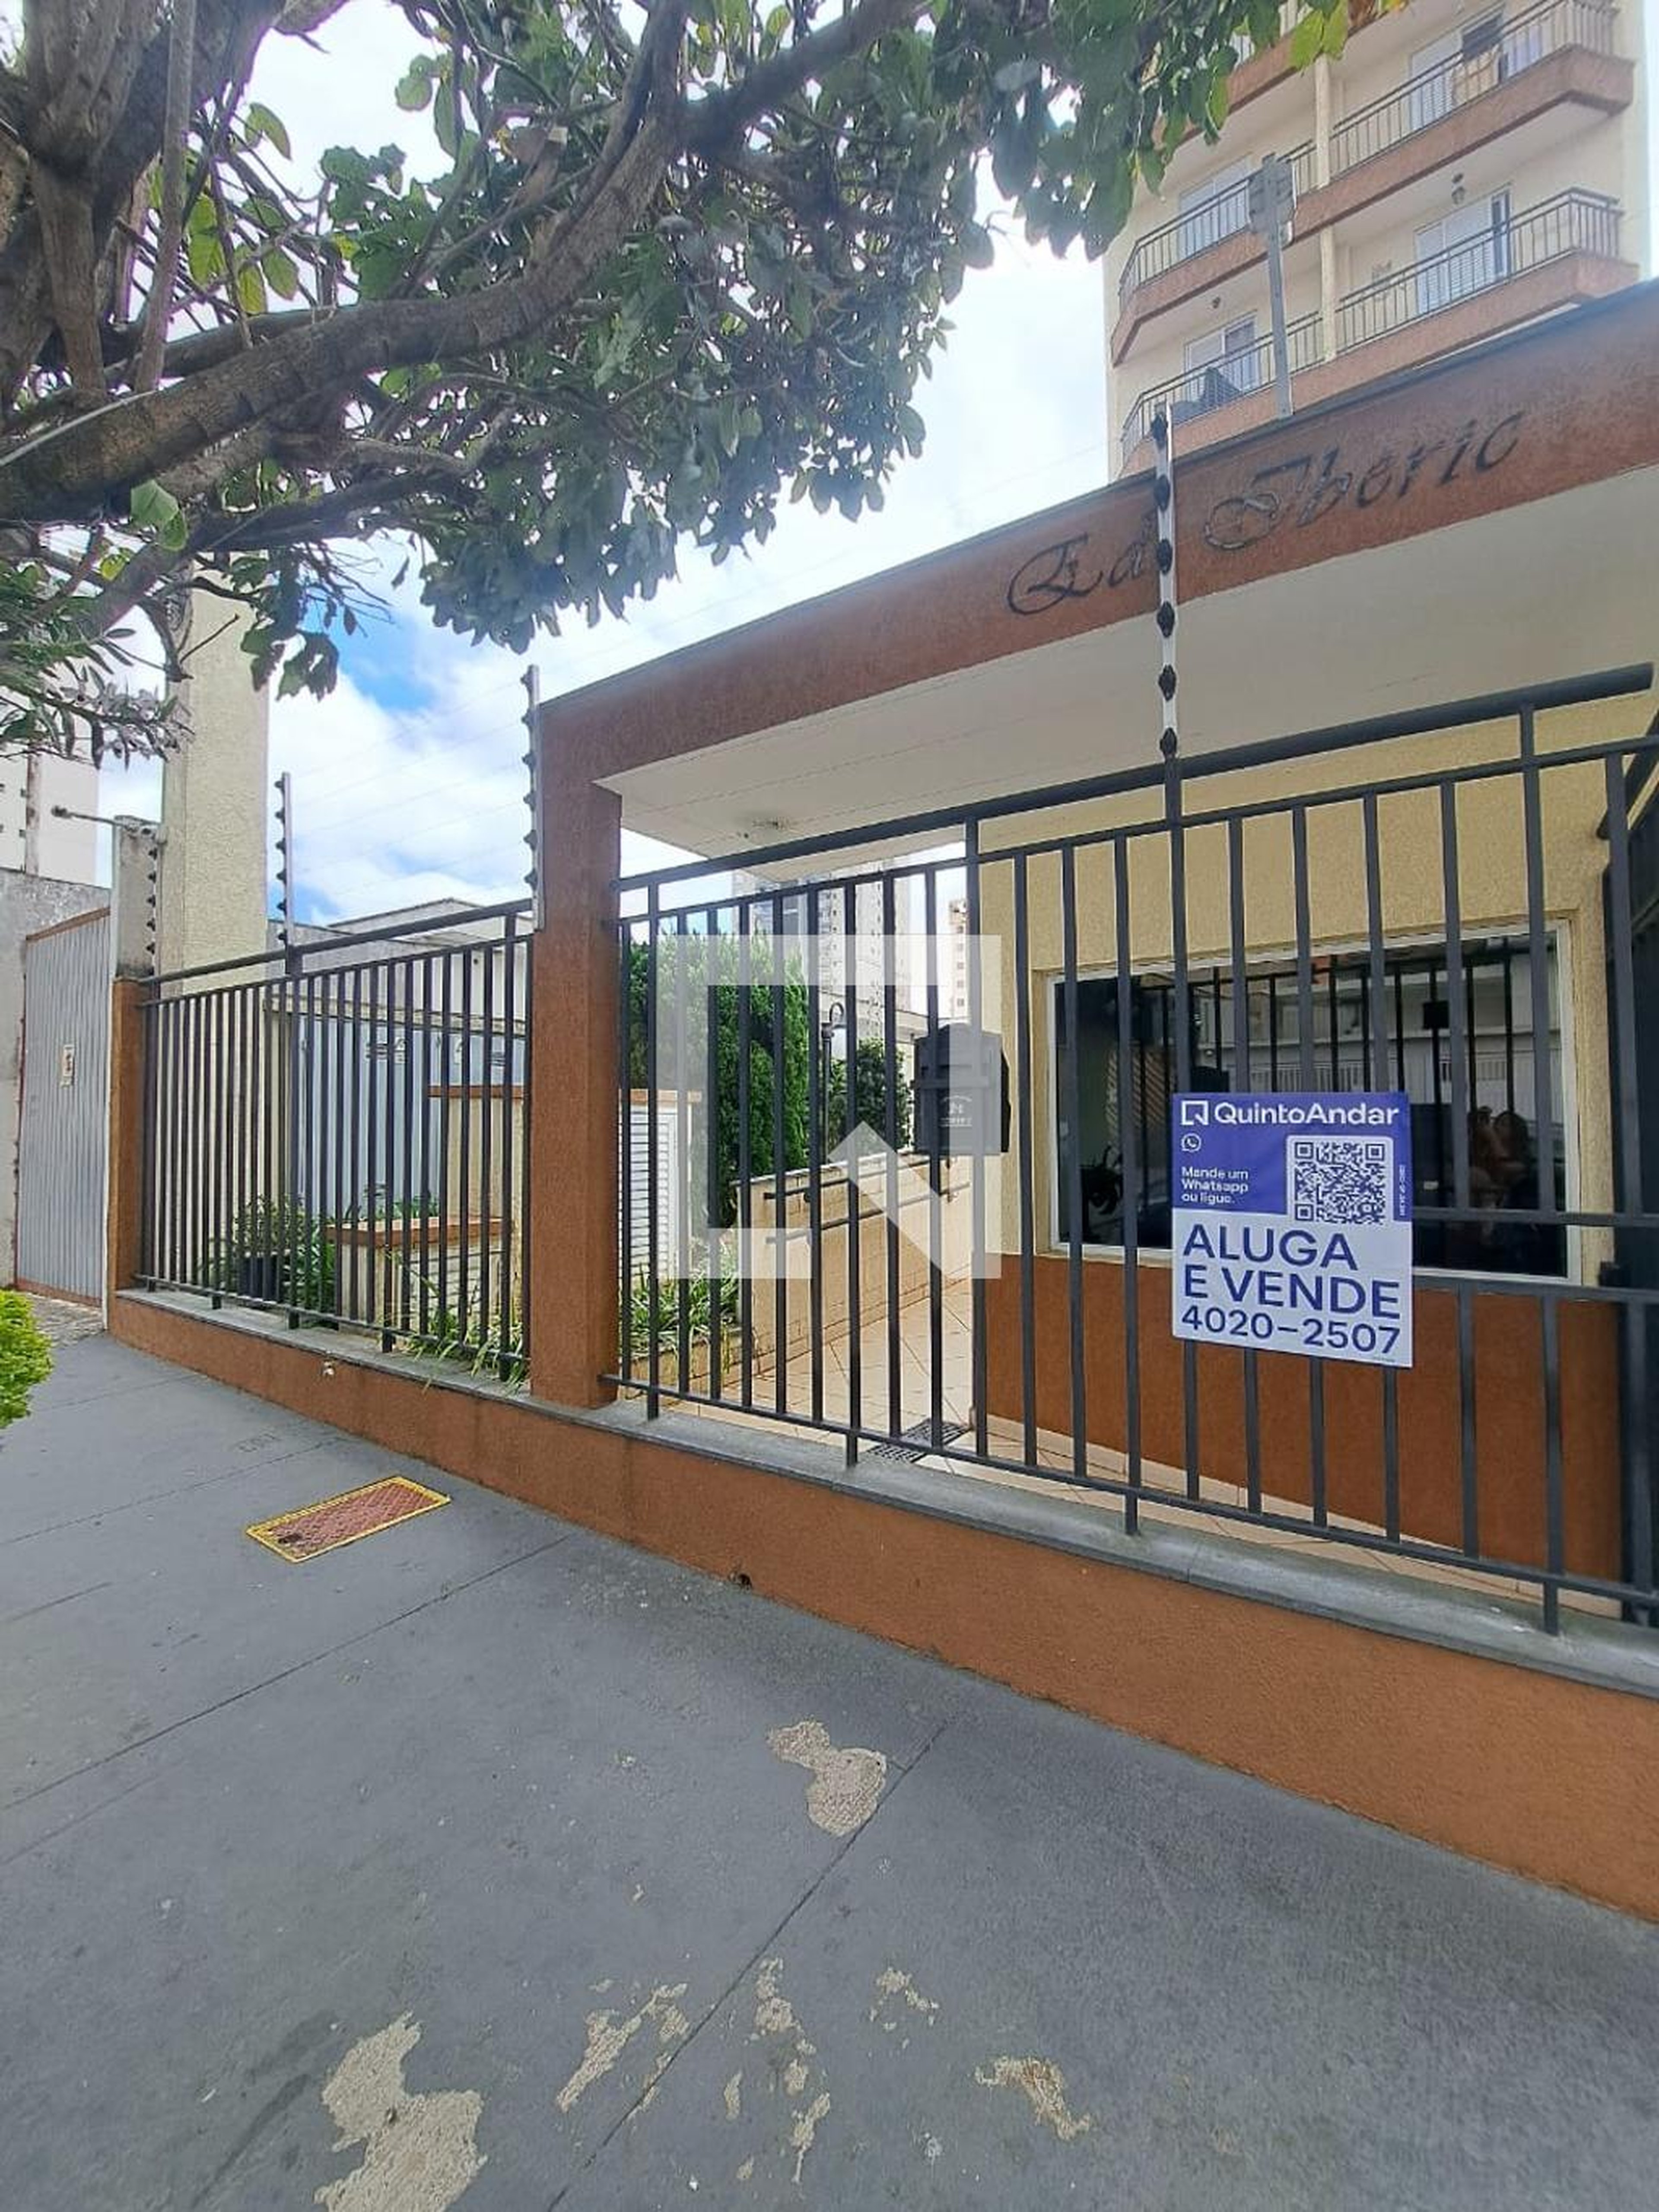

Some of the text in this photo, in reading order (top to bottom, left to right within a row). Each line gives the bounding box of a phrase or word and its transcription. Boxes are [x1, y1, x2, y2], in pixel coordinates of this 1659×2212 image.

[1214, 1102, 1399, 1124] QuintoAndar
[1181, 1166, 1249, 1180] Mande um
[1181, 1194, 1198, 1202] ou
[1183, 1224, 1358, 1271] ALUGA
[1185, 1265, 1400, 1320] E VENDE
[1181, 1305, 1401, 1354] 4020-2507
